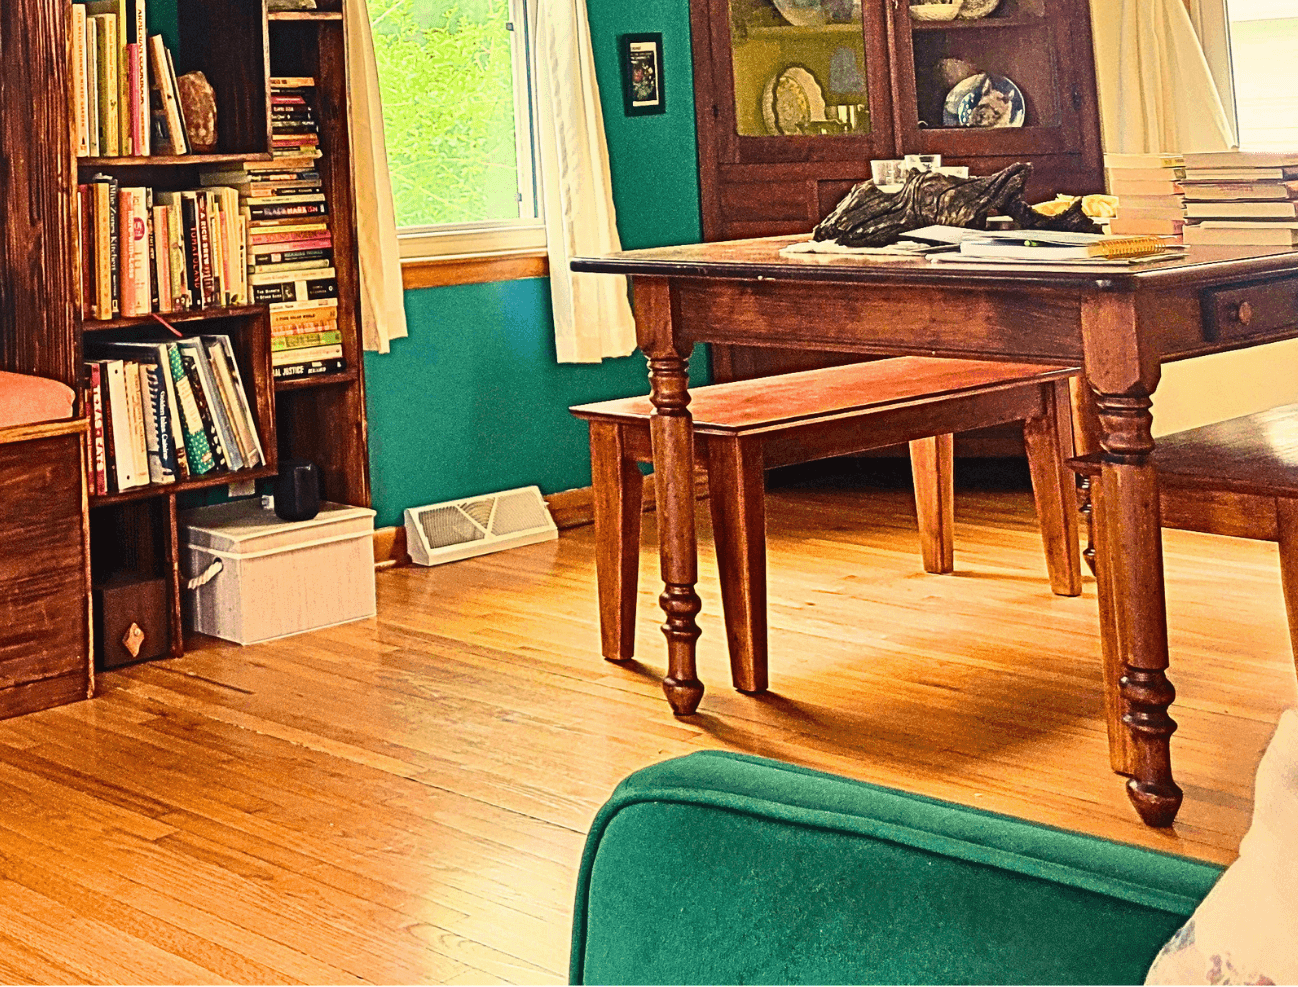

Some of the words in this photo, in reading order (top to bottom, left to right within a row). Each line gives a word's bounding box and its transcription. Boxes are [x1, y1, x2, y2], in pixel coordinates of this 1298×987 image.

[137, 9, 145, 54] ARMENIAN
[200, 220, 209, 241] RICH
[111, 235, 119, 271] Kitchen
[189, 227, 202, 289] TOMATOLAND
[202, 242, 211, 266] BREW
[282, 365, 305, 376] JUSTICE
[93, 384, 102, 429] TEXAS
[95, 437, 104, 472] EATS
